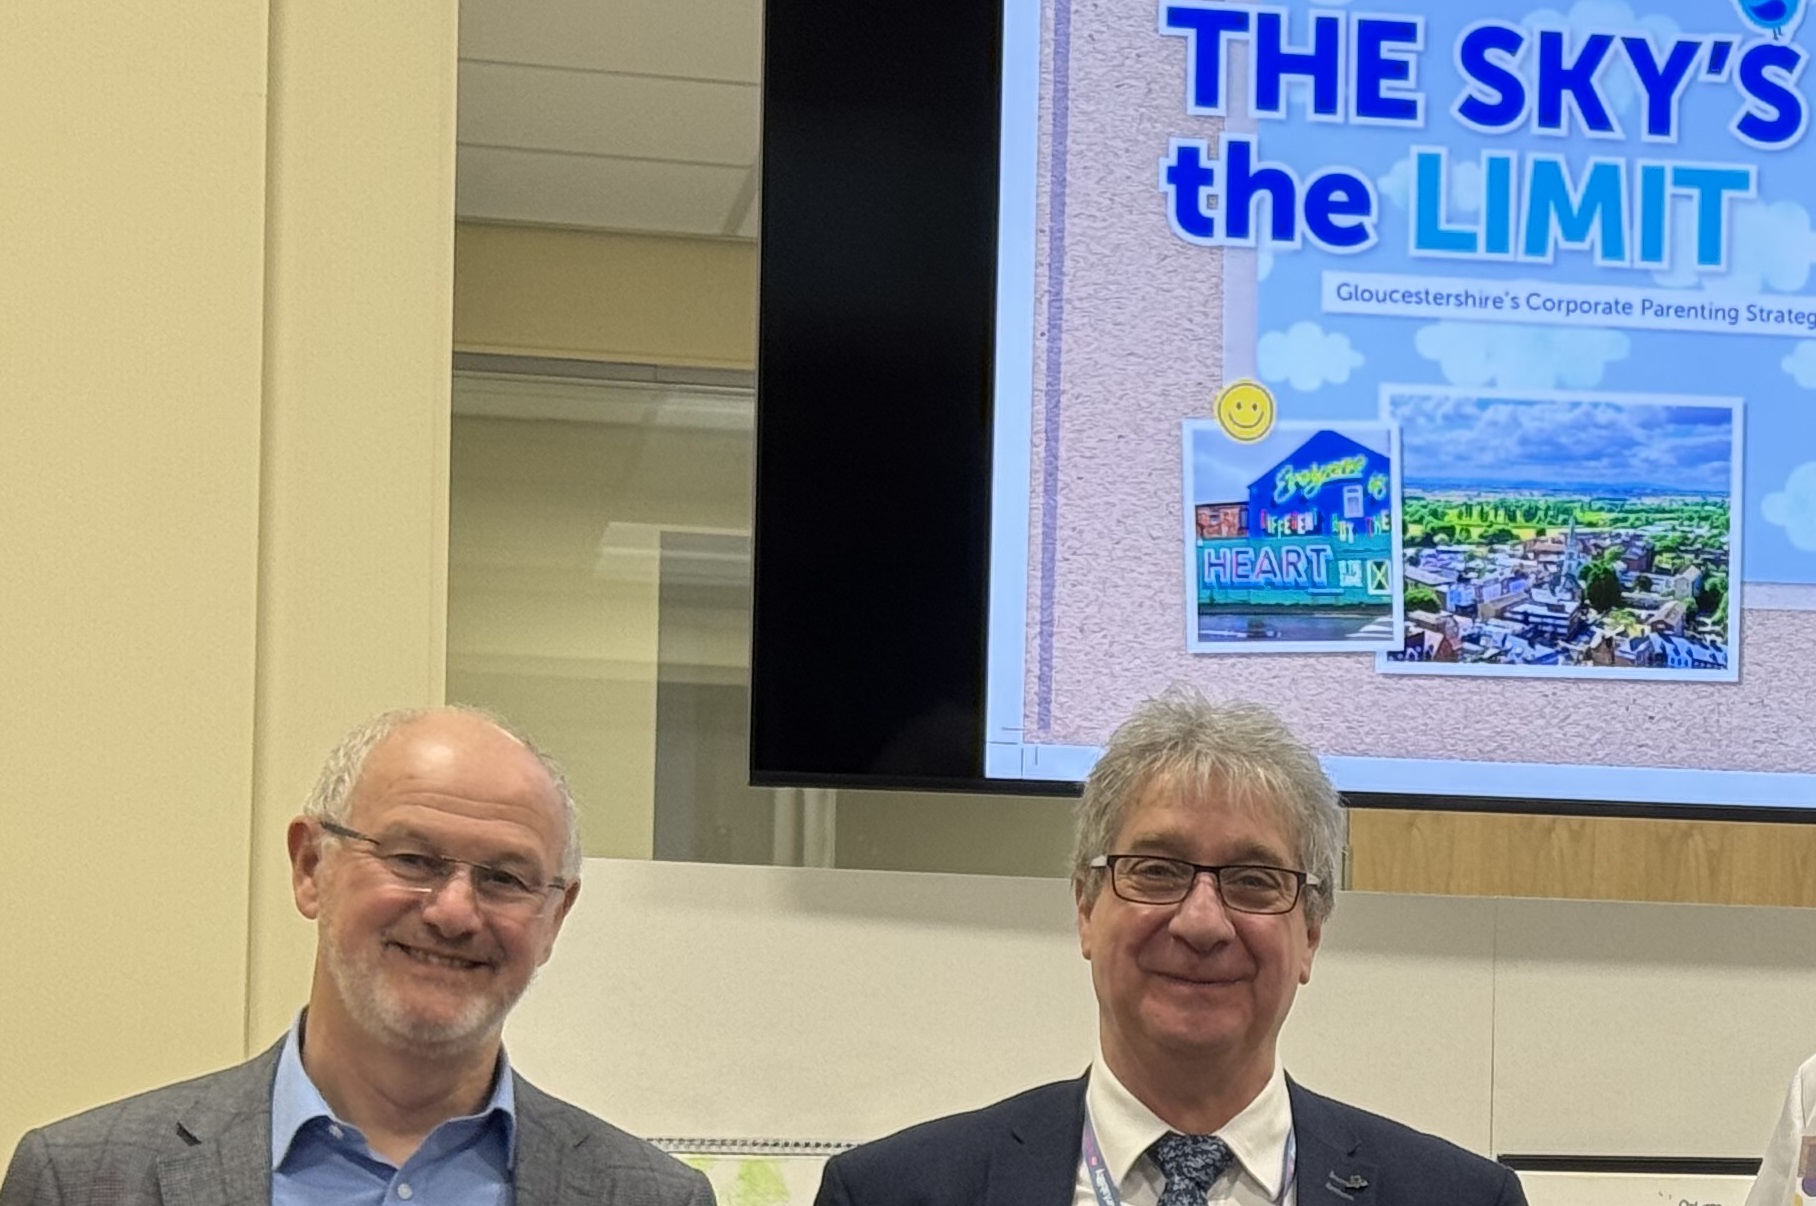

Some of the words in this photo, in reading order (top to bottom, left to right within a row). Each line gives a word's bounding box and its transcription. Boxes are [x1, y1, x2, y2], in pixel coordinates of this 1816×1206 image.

[1164, 6, 1421, 123] THE
[1457, 23, 1805, 144] SKY'S
[1164, 138, 1373, 248] the
[1412, 150, 1753, 268] LIMIT
[1336, 282, 1521, 312] Gloucestershire's
[1526, 293, 1634, 318] Corporate
[1640, 299, 1740, 326] Parenting
[1203, 544, 1335, 588] HEART
